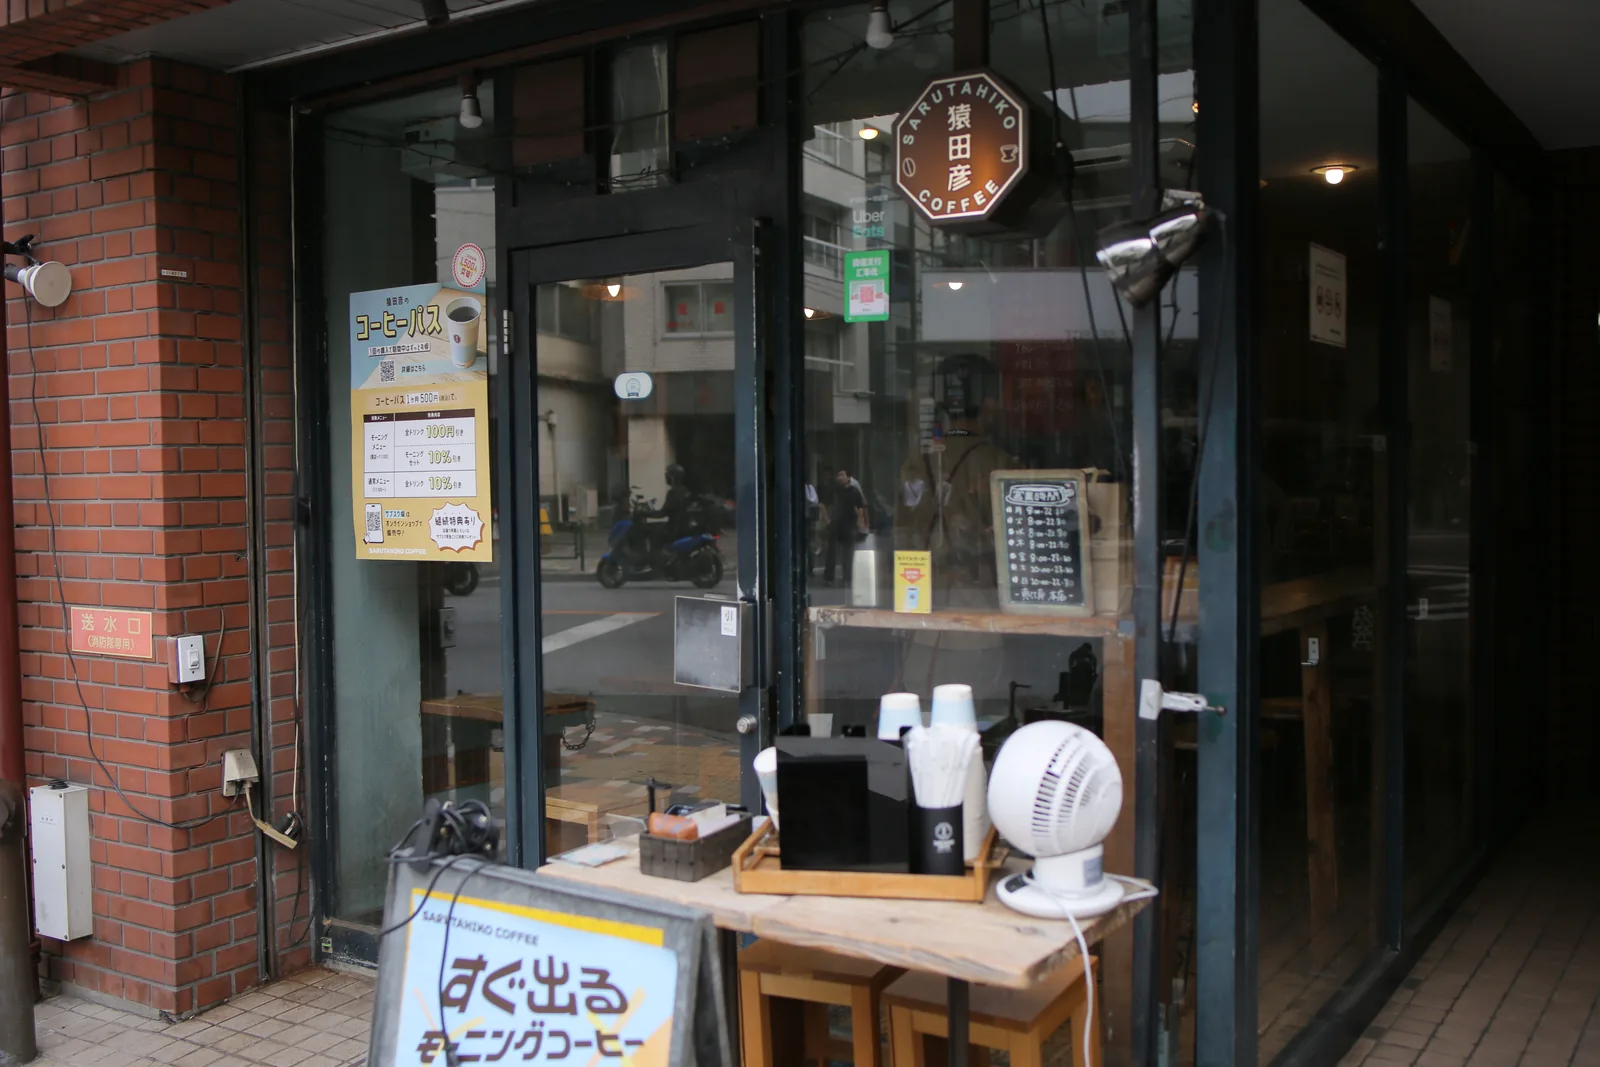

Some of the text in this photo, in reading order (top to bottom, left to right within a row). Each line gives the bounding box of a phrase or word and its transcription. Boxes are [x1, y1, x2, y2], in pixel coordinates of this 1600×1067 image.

[902, 82, 1016, 145] SARUTAHIKO
[947, 103, 972, 192] 猿田彦
[919, 179, 999, 214] COFFEE
[852, 210, 885, 224] Uber
[852, 223, 885, 239] Eats
[356, 305, 442, 341] コーヒーパス
[81, 613, 141, 635] 送水口
[495, 927, 539, 947] COFFEE
[441, 953, 628, 1016] すぐ出る
[416, 1020, 644, 1064] モーニングコーヒー
